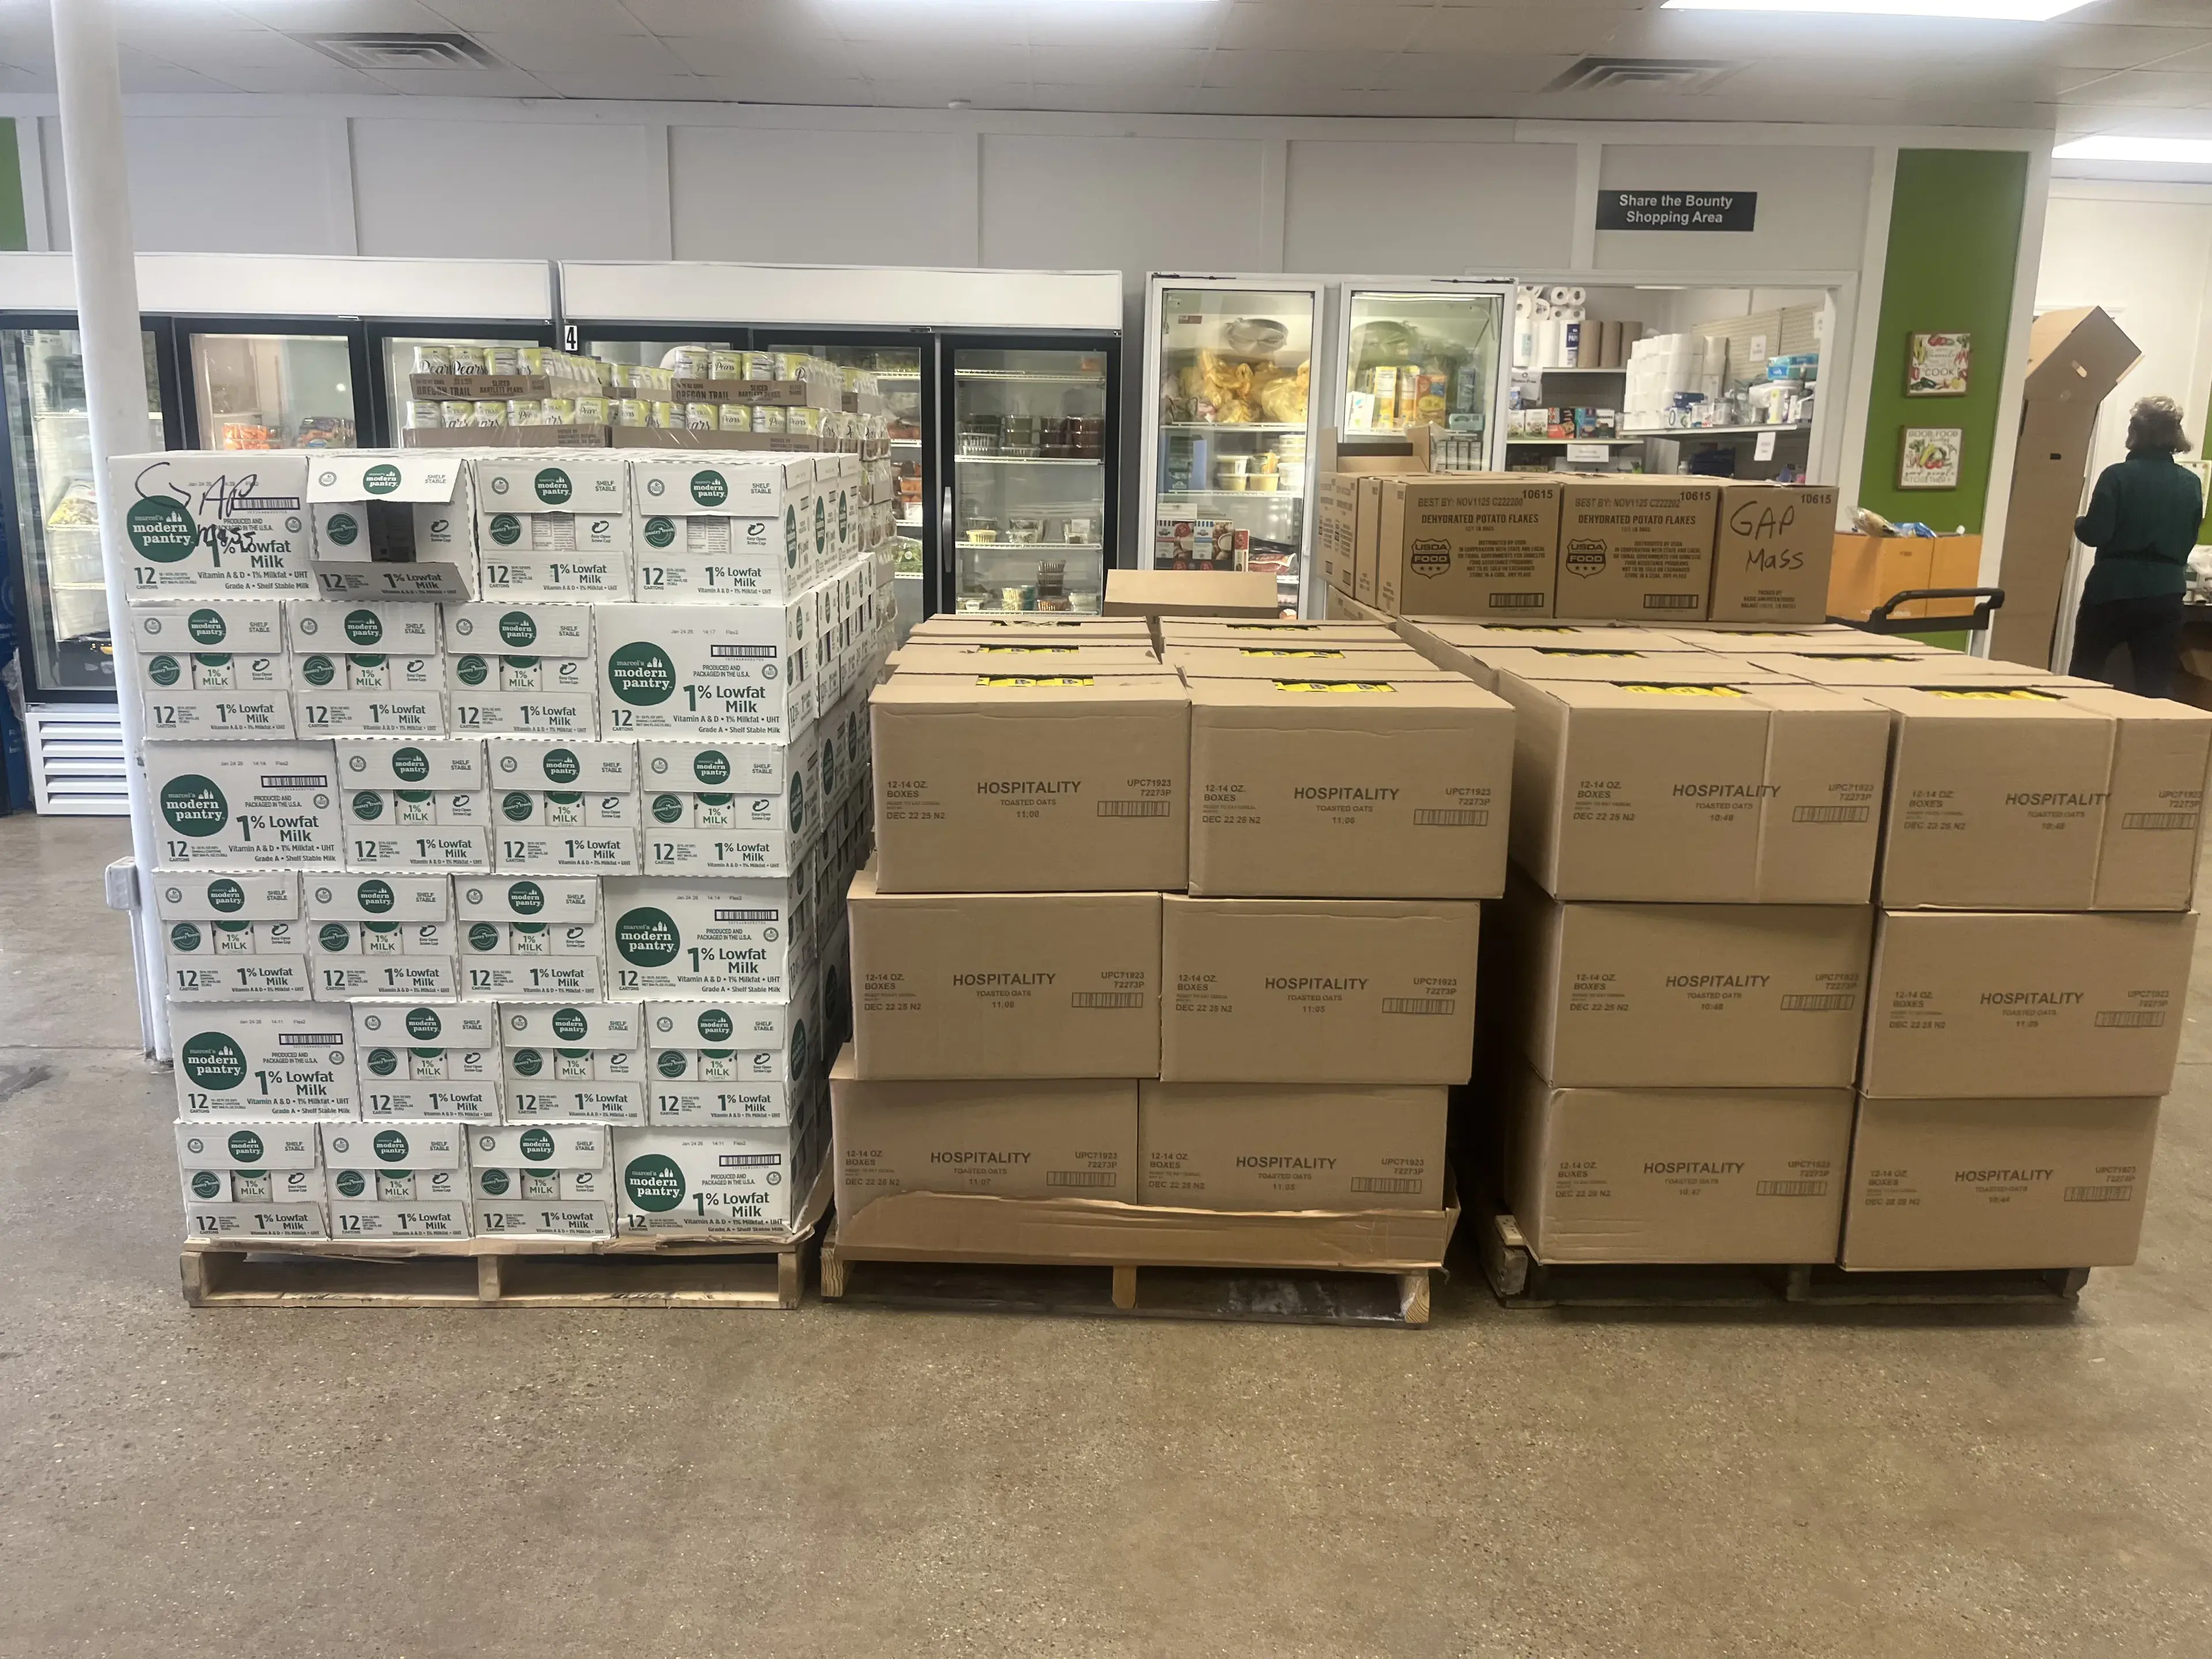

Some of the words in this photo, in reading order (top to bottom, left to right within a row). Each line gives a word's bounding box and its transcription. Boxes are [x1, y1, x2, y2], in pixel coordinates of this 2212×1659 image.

[1620, 194, 1657, 206] Share
[1661, 195, 1681, 206] the
[1685, 195, 1733, 209] Bounty
[1626, 211, 1688, 225] Shopping
[1692, 211, 1722, 223] Area
[566, 327, 575, 349] 4
[714, 362, 734, 371] Pears
[450, 387, 471, 396] TRAIL
[709, 391, 729, 400] TRAIL
[723, 415, 740, 423] Pears
[135, 461, 257, 520] GAP
[1522, 490, 1552, 498] 10615
[1680, 492, 1710, 501] 10615
[1801, 494, 1831, 503] 10615
[1418, 498, 1439, 507] BEST
[1441, 498, 1454, 506] BY:
[1457, 498, 1490, 506] NOV1125
[1575, 498, 1596, 507] BEST
[1613, 498, 1647, 507] NOV1125
[1422, 514, 1473, 524] DEHYDRATED
[1476, 514, 1506, 523] POTATO
[1509, 514, 1539, 523] FLAKES
[1579, 515, 1630, 524] DEHYDRATED
[1633, 516, 1662, 524] POTATO
[1666, 516, 1695, 524] FLAKES
[1730, 501, 1794, 540] GAP
[132, 523, 187, 533] modern
[143, 535, 191, 545] pantry
[550, 564, 569, 582] 1%
[573, 565, 607, 573] Lowfat
[579, 575, 601, 583] Milk
[207, 669, 221, 677] 1%
[614, 668, 667, 677] modern
[202, 677, 228, 686] MILK
[623, 679, 670, 690] pantry
[683, 684, 711, 711] 1%
[717, 686, 765, 698] Lowfat
[726, 700, 757, 713] Milk
[612, 710, 632, 726] 12
[978, 781, 1081, 794] HOSPITALITY
[1673, 785, 1781, 798] HOSPITALITY
[1294, 787, 1399, 801] HOSPITALITY
[2005, 793, 2111, 806] HOSPITALITY
[166, 800, 219, 809] modern
[1459, 798, 1490, 806] 72273P
[176, 810, 222, 821] pantry
[236, 815, 265, 841] 1%
[270, 816, 319, 827] Lowfat
[281, 830, 312, 842] Milk
[621, 931, 672, 940] modern
[629, 942, 675, 952] pantry
[688, 948, 714, 972] 1%
[720, 948, 766, 960] Lowfat
[729, 962, 758, 974] Milk
[953, 974, 1056, 986] HOSPITALITY
[1265, 978, 1369, 990] HOSPITALITY
[1666, 975, 1770, 987] HOSPITALITY
[1980, 992, 2084, 1005] HOSPITALITY
[188, 1055, 238, 1064] modern
[197, 1066, 241, 1076] pantry
[287, 1071, 334, 1082] Lowfat
[930, 1152, 1031, 1164] HOSPITALITY
[1236, 1156, 1337, 1169] HOSPITALITY
[1643, 1162, 1745, 1174] HOSPITALITY
[1955, 1169, 2054, 1183] HOSPITALITY
[630, 1177, 677, 1187] modern
[637, 1187, 680, 1198] pantry
[692, 1192, 719, 1216] 1%
[724, 1192, 770, 1204] Lowfat
[733, 1206, 762, 1217] Milk
